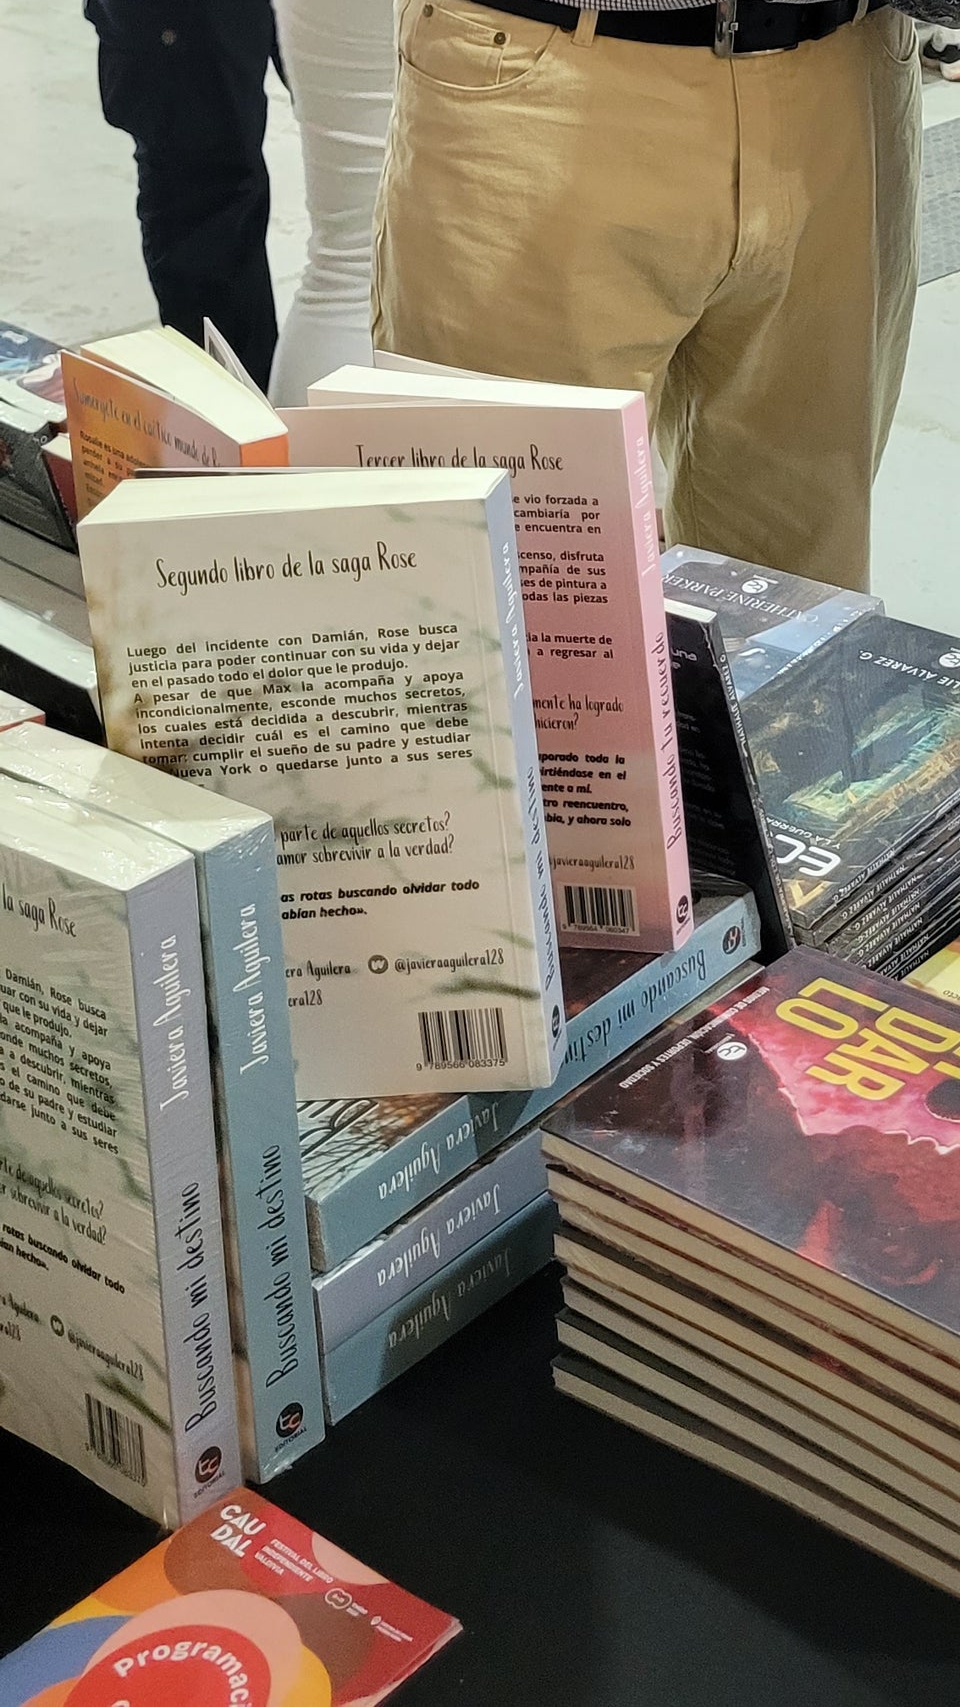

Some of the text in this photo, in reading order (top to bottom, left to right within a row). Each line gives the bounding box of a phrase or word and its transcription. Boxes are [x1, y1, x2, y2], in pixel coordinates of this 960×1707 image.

[451, 446, 468, 468] de
[473, 446, 487, 468] la
[492, 453, 526, 479] saga
[530, 444, 564, 471] Rose
[513, 508, 601, 523] cambiaría por
[524, 494, 599, 506] vio forzada a
[525, 523, 602, 535] encuentra en
[156, 541, 418, 596] Segundo libro de la saga Rose
[126, 623, 458, 659] Luego del incidente con Damián, Rose busca
[128, 638, 461, 675] justicia para poder continuar con su vida y dejar
[858, 650, 874, 662] G.
[873, 655, 938, 683] ÁLVAREZ
[135, 685, 466, 719] incondicionalmente, esconde muchos secretos,
[562, 798, 629, 813] reencuentro,
[662, 753, 683, 850] Buscando
[280, 810, 451, 851] parte de aquellos secretos?
[276, 833, 455, 866] amor sobrevivir a la verdad?
[306, 947, 504, 982] Aguilera @javieraaguilera128
[233, 903, 271, 1075] Javiera Aguilera
[616, 947, 707, 1030] Buscando mi
[153, 934, 191, 1112] Javiera Aguilera
[654, 1037, 693, 1064] DEPORTES
[618, 1062, 656, 1089] SOCIEDAD
[255, 1145, 299, 1388] Buscando mi destino
[174, 1182, 218, 1433] Buscando mi destino
[220, 1504, 266, 1536] CAU
[209, 1524, 252, 1558] DAL
[254, 1551, 285, 1576] VALDIVIA
[270, 1538, 334, 1584] FESTIVAL DEL LIBRO
